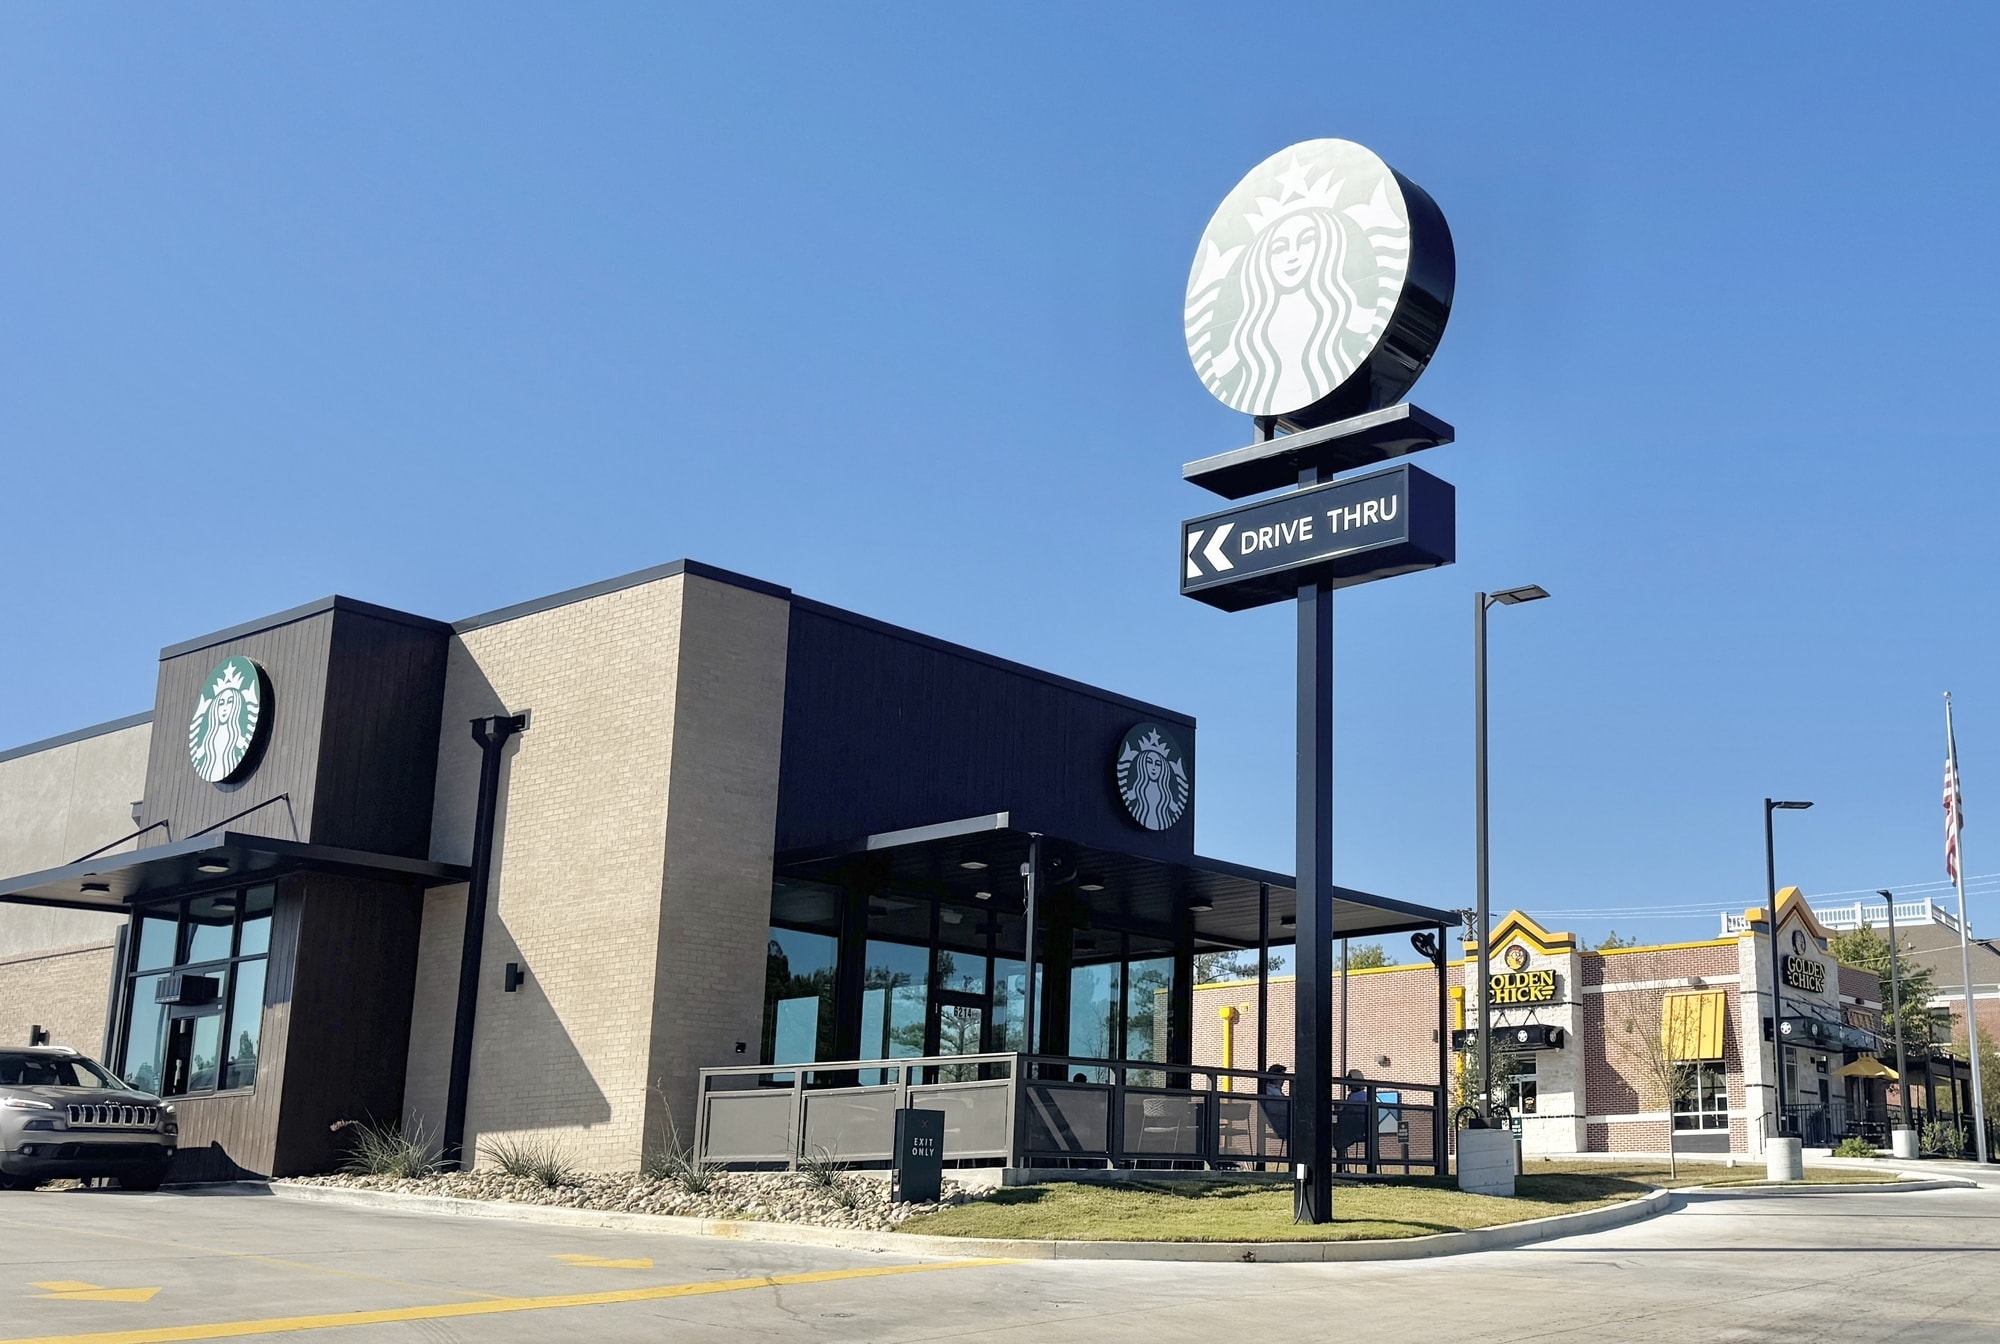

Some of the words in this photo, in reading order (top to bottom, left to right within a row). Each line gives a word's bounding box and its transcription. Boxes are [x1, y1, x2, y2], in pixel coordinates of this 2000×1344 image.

[1241, 516, 1313, 555] DRIVE
[1327, 495, 1397, 534] THRU
[1788, 955, 1826, 979] GOLDEN
[1489, 970, 1554, 990] OLDEN
[1792, 972, 1823, 992] CHICK
[953, 1006, 972, 1018] 6214
[911, 1147, 935, 1157] ONLY
[913, 1137, 934, 1147] EXIT
